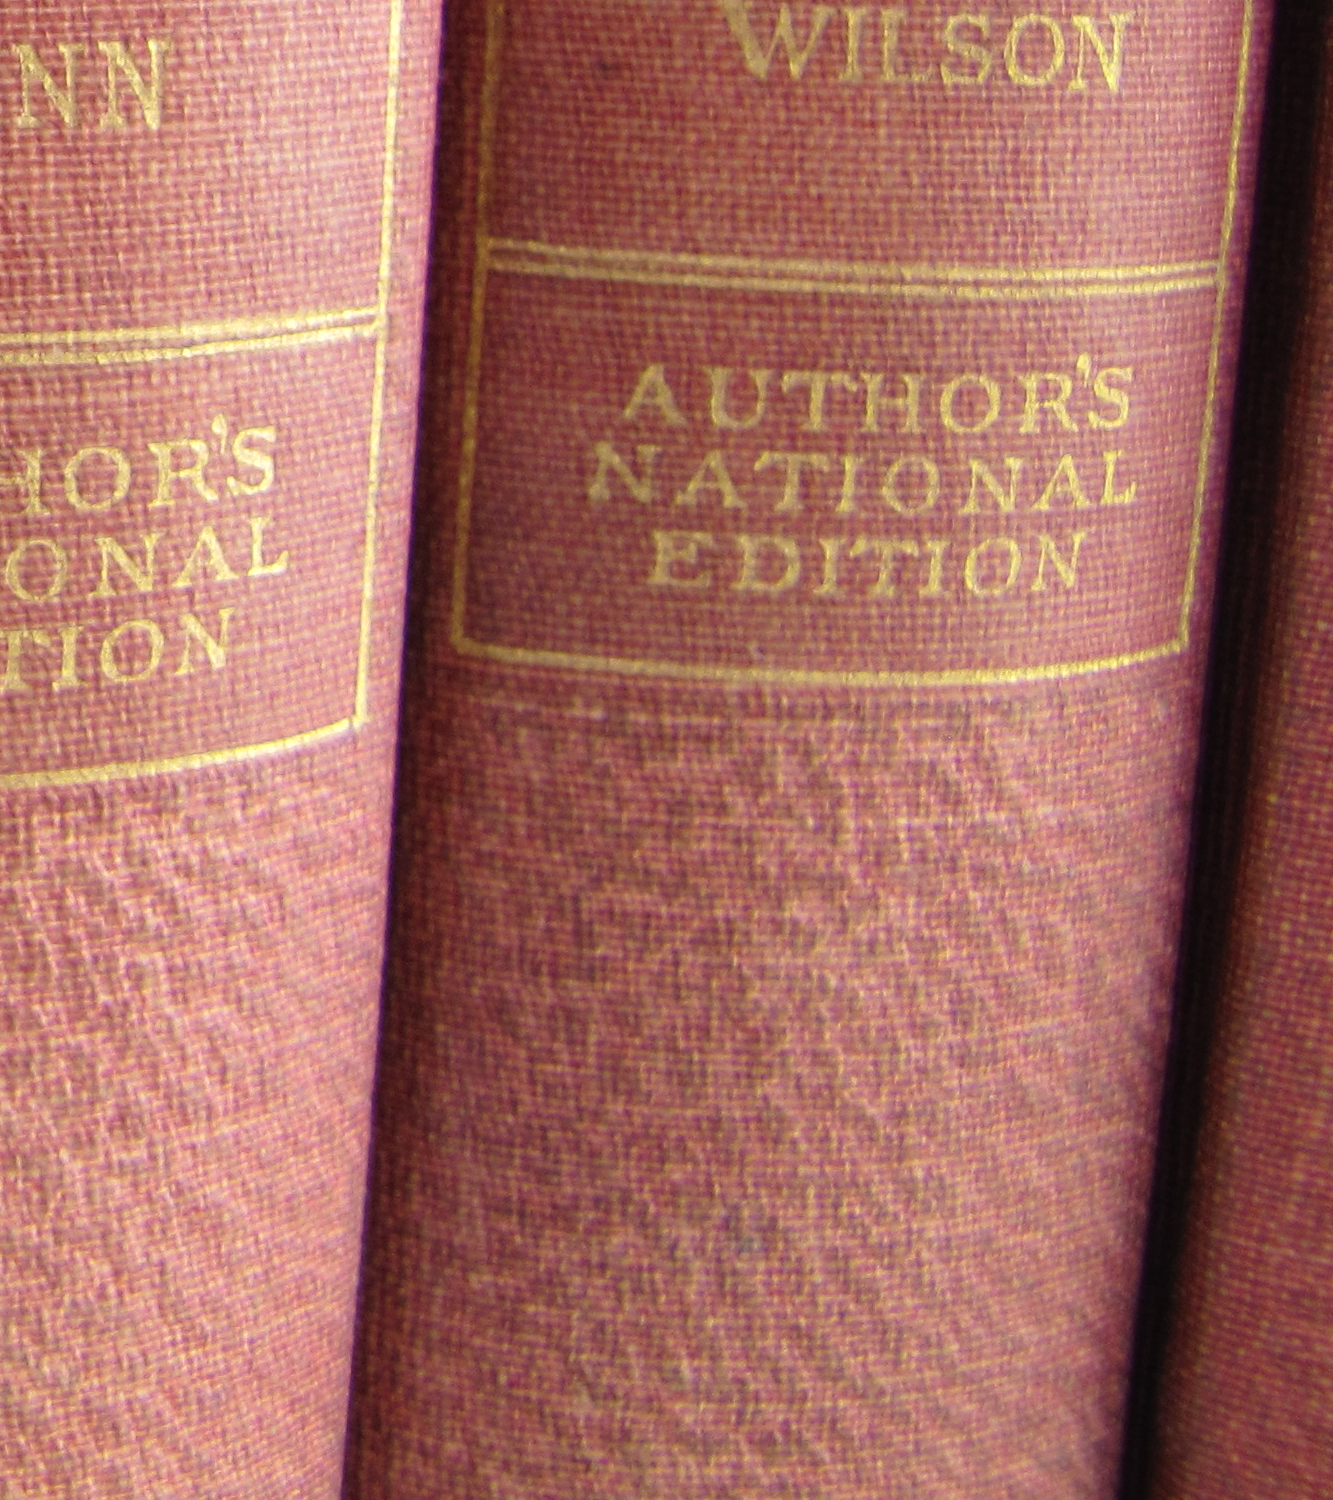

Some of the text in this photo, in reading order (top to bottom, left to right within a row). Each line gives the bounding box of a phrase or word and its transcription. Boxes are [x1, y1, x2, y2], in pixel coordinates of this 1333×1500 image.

[621, 353, 1133, 433] AUTHOR'S
[587, 441, 1137, 515] NATIONAL
[649, 530, 1087, 597] EDITION
